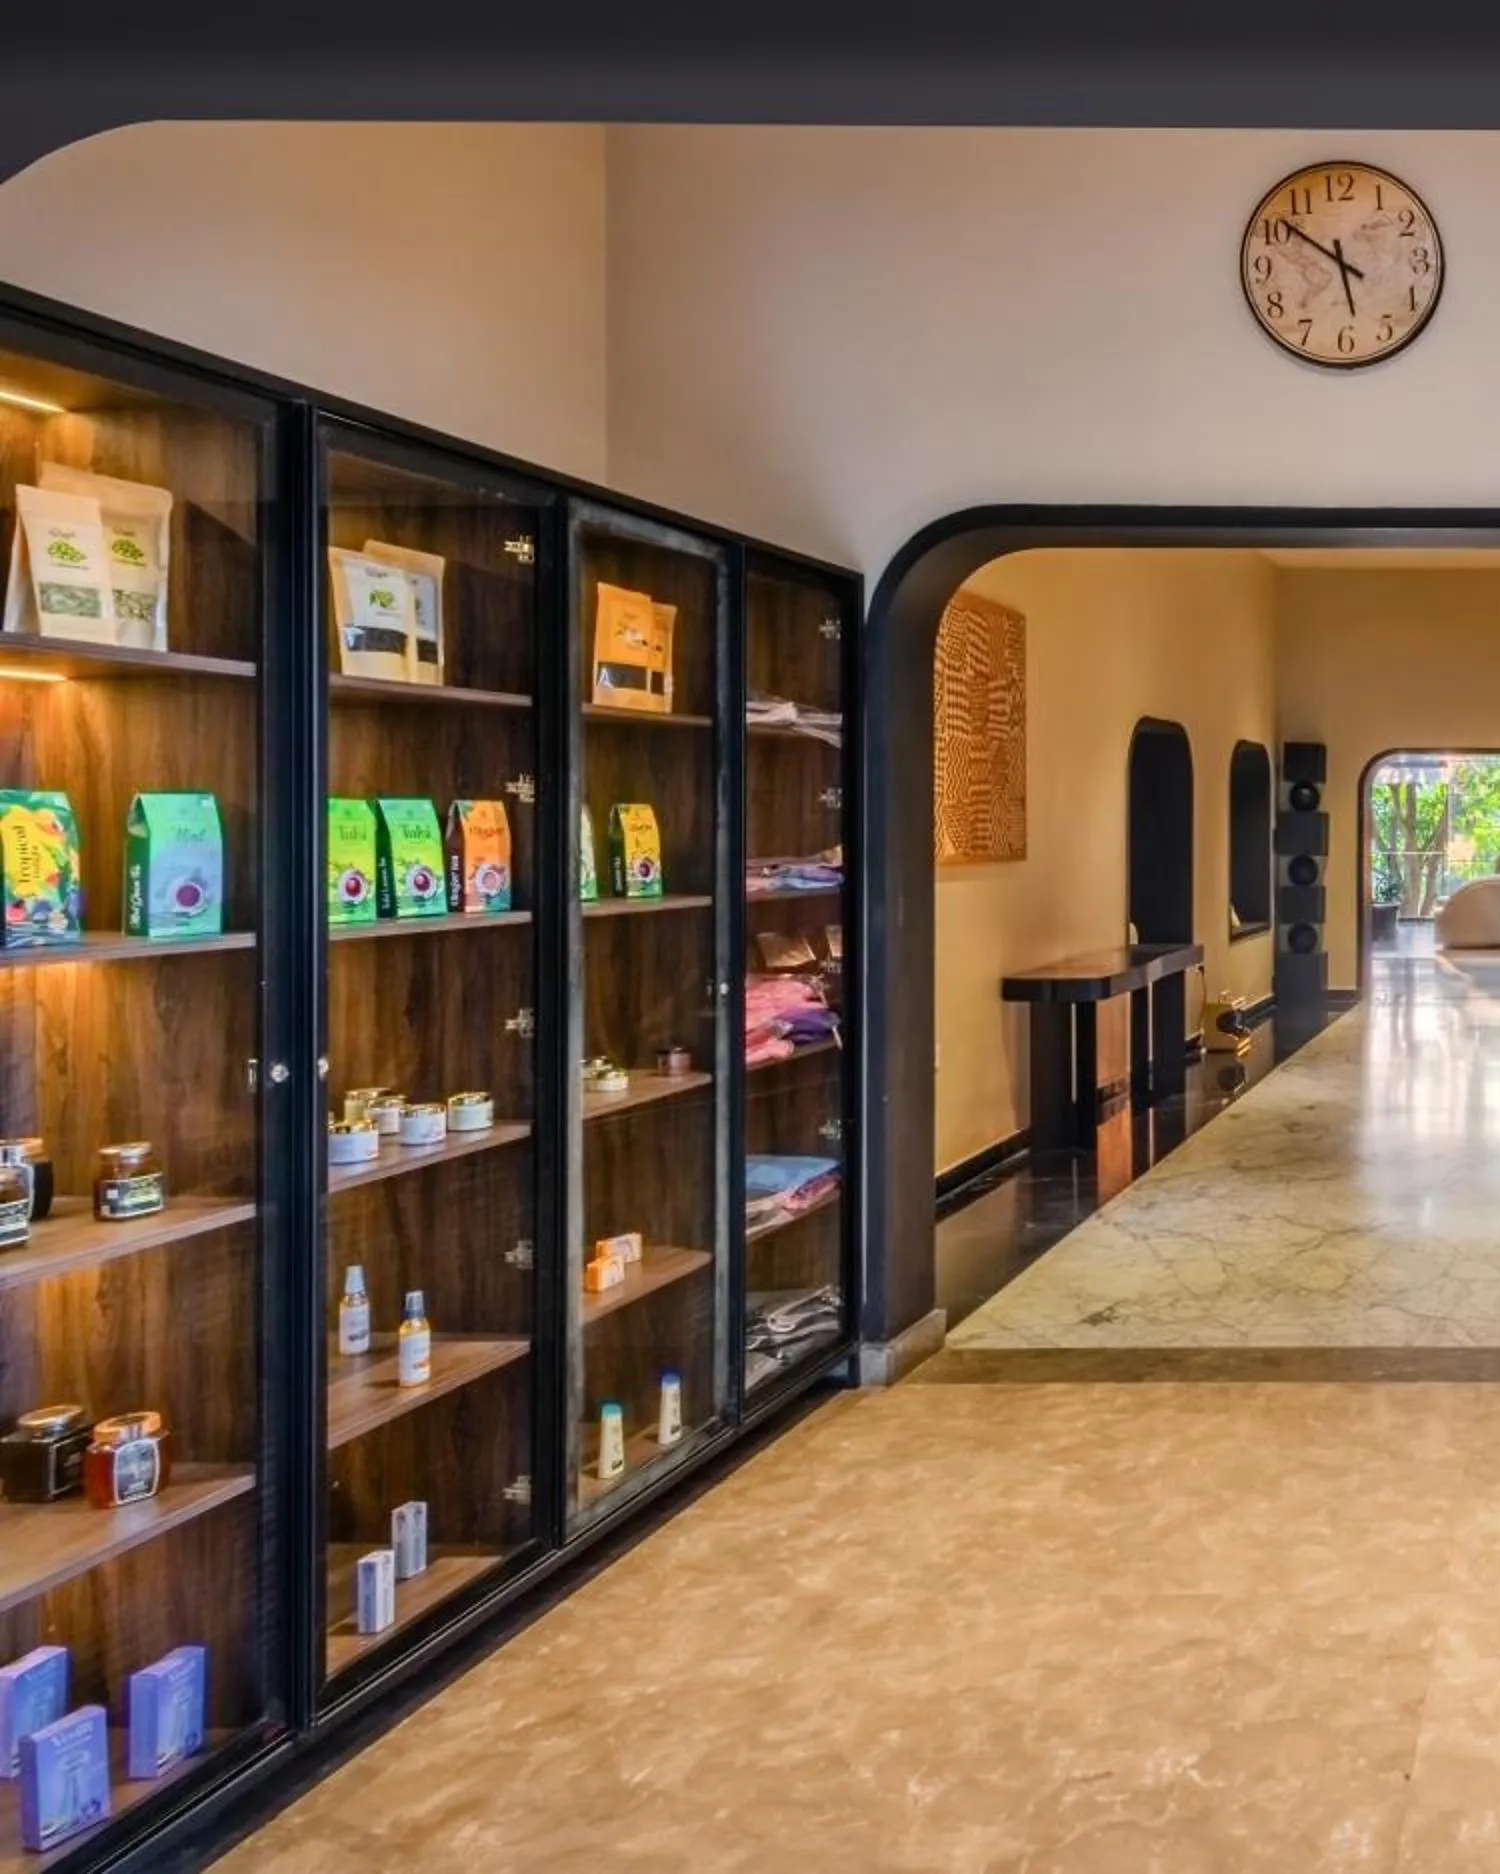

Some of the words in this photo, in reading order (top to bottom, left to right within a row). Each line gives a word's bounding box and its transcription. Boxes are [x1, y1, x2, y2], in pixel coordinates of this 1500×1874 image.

[1324, 172, 1355, 202] 12
[1375, 184, 1384, 211] 1
[1289, 188, 1313, 216] 11
[1262, 218, 1292, 246] 10
[1398, 209, 1415, 238] 2
[1253, 255, 1273, 284] 9
[1409, 247, 1430, 275] 3
[1266, 291, 1285, 319] 8
[1297, 318, 1313, 347] 7
[1337, 326, 1355, 354] 6
[1376, 315, 1393, 342] 5
[11, 825, 32, 885] Tropical
